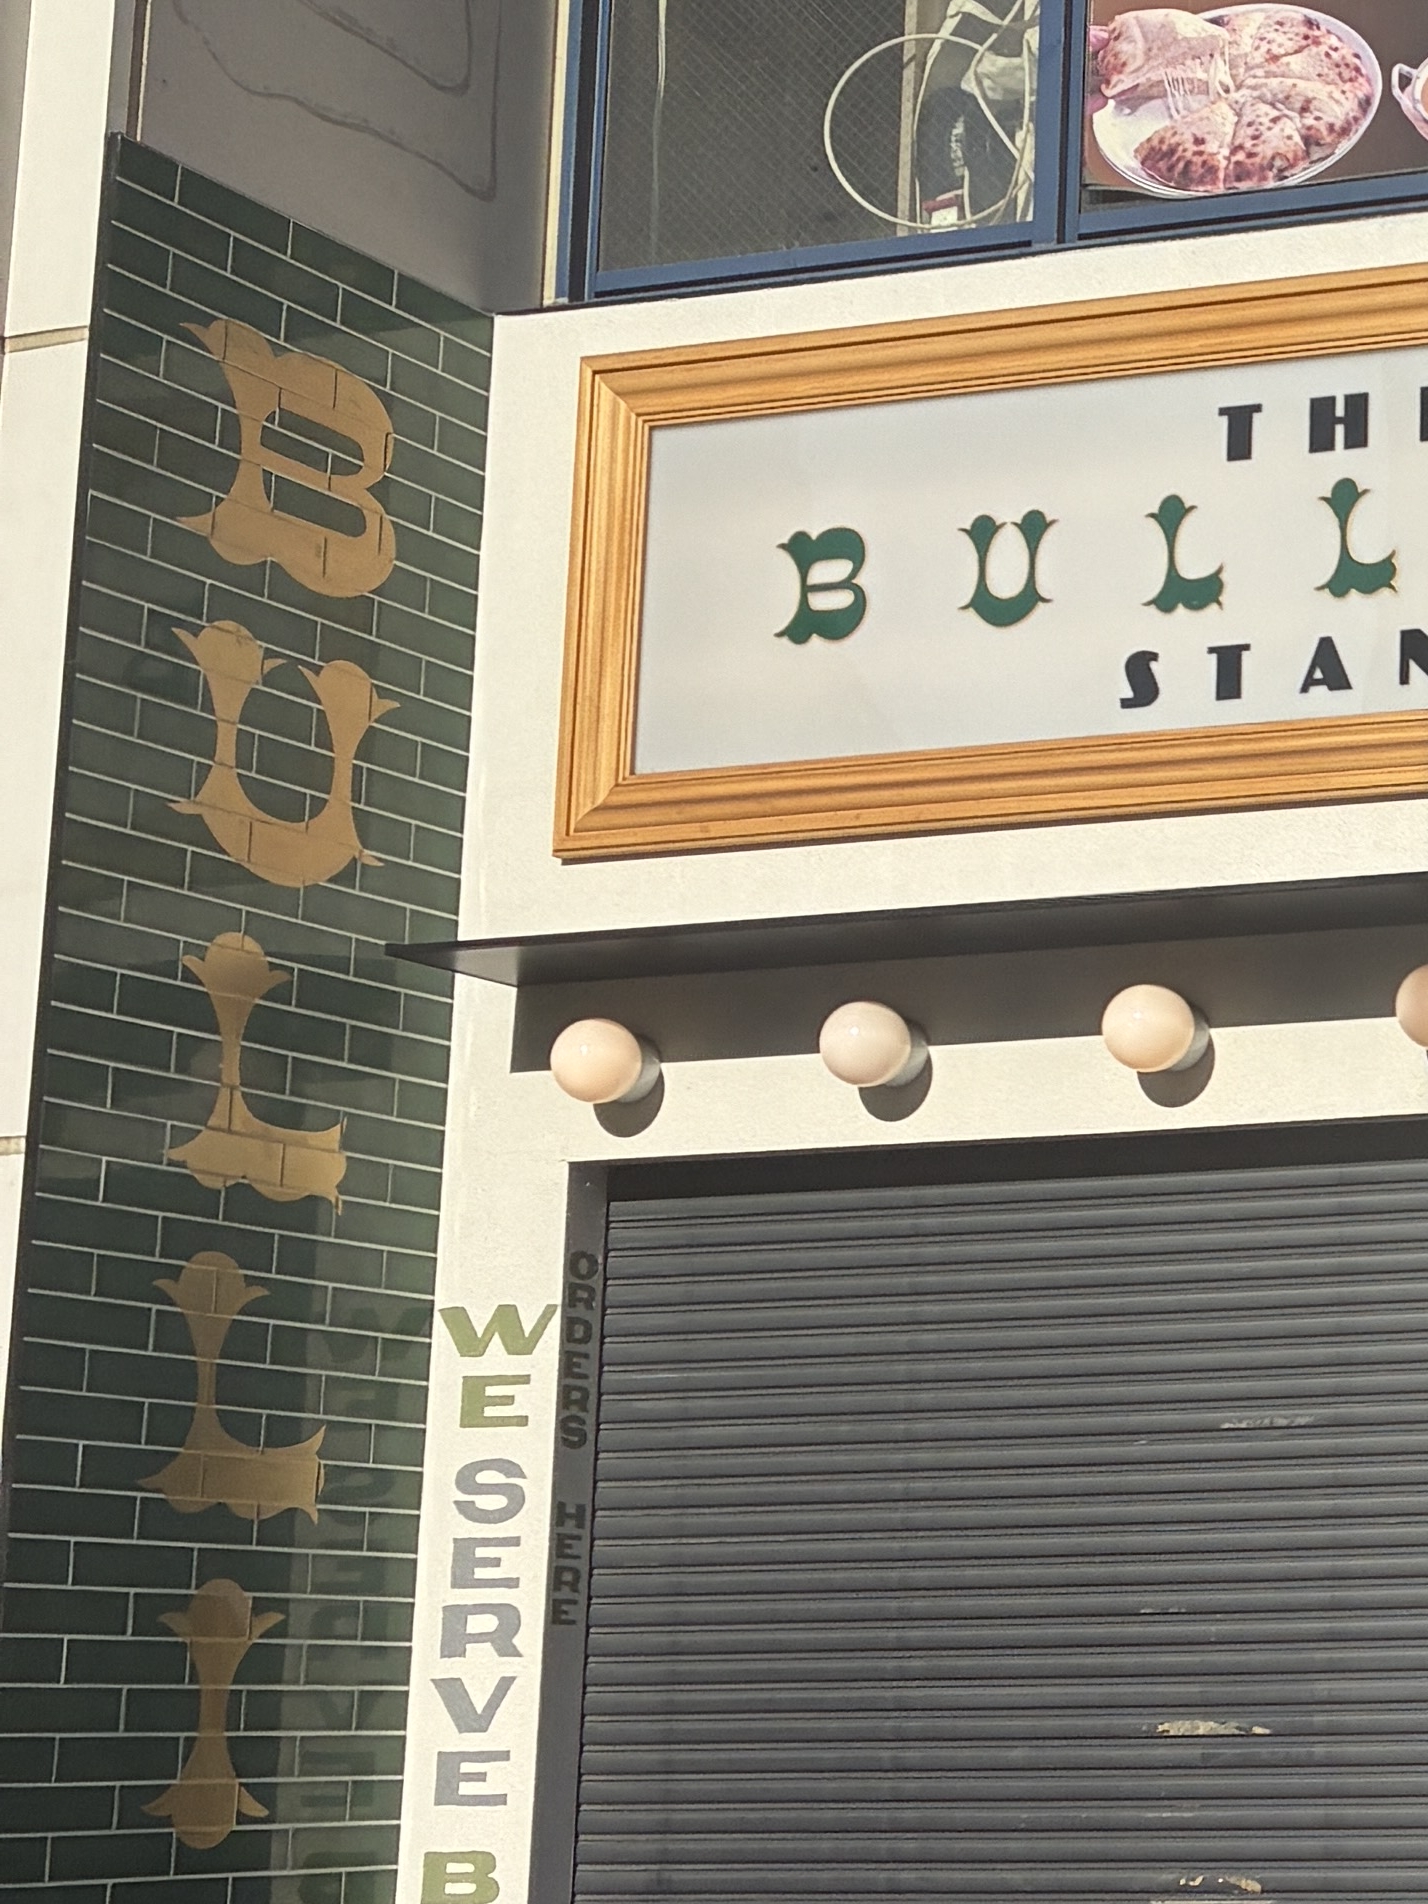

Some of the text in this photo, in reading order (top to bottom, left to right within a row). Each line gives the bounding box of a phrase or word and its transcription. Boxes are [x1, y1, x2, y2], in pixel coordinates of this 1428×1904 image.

[437, 1303, 558, 1428] WE
[550, 1250, 599, 1626] ORDERS HERE
[430, 1457, 528, 1807] SERVE
